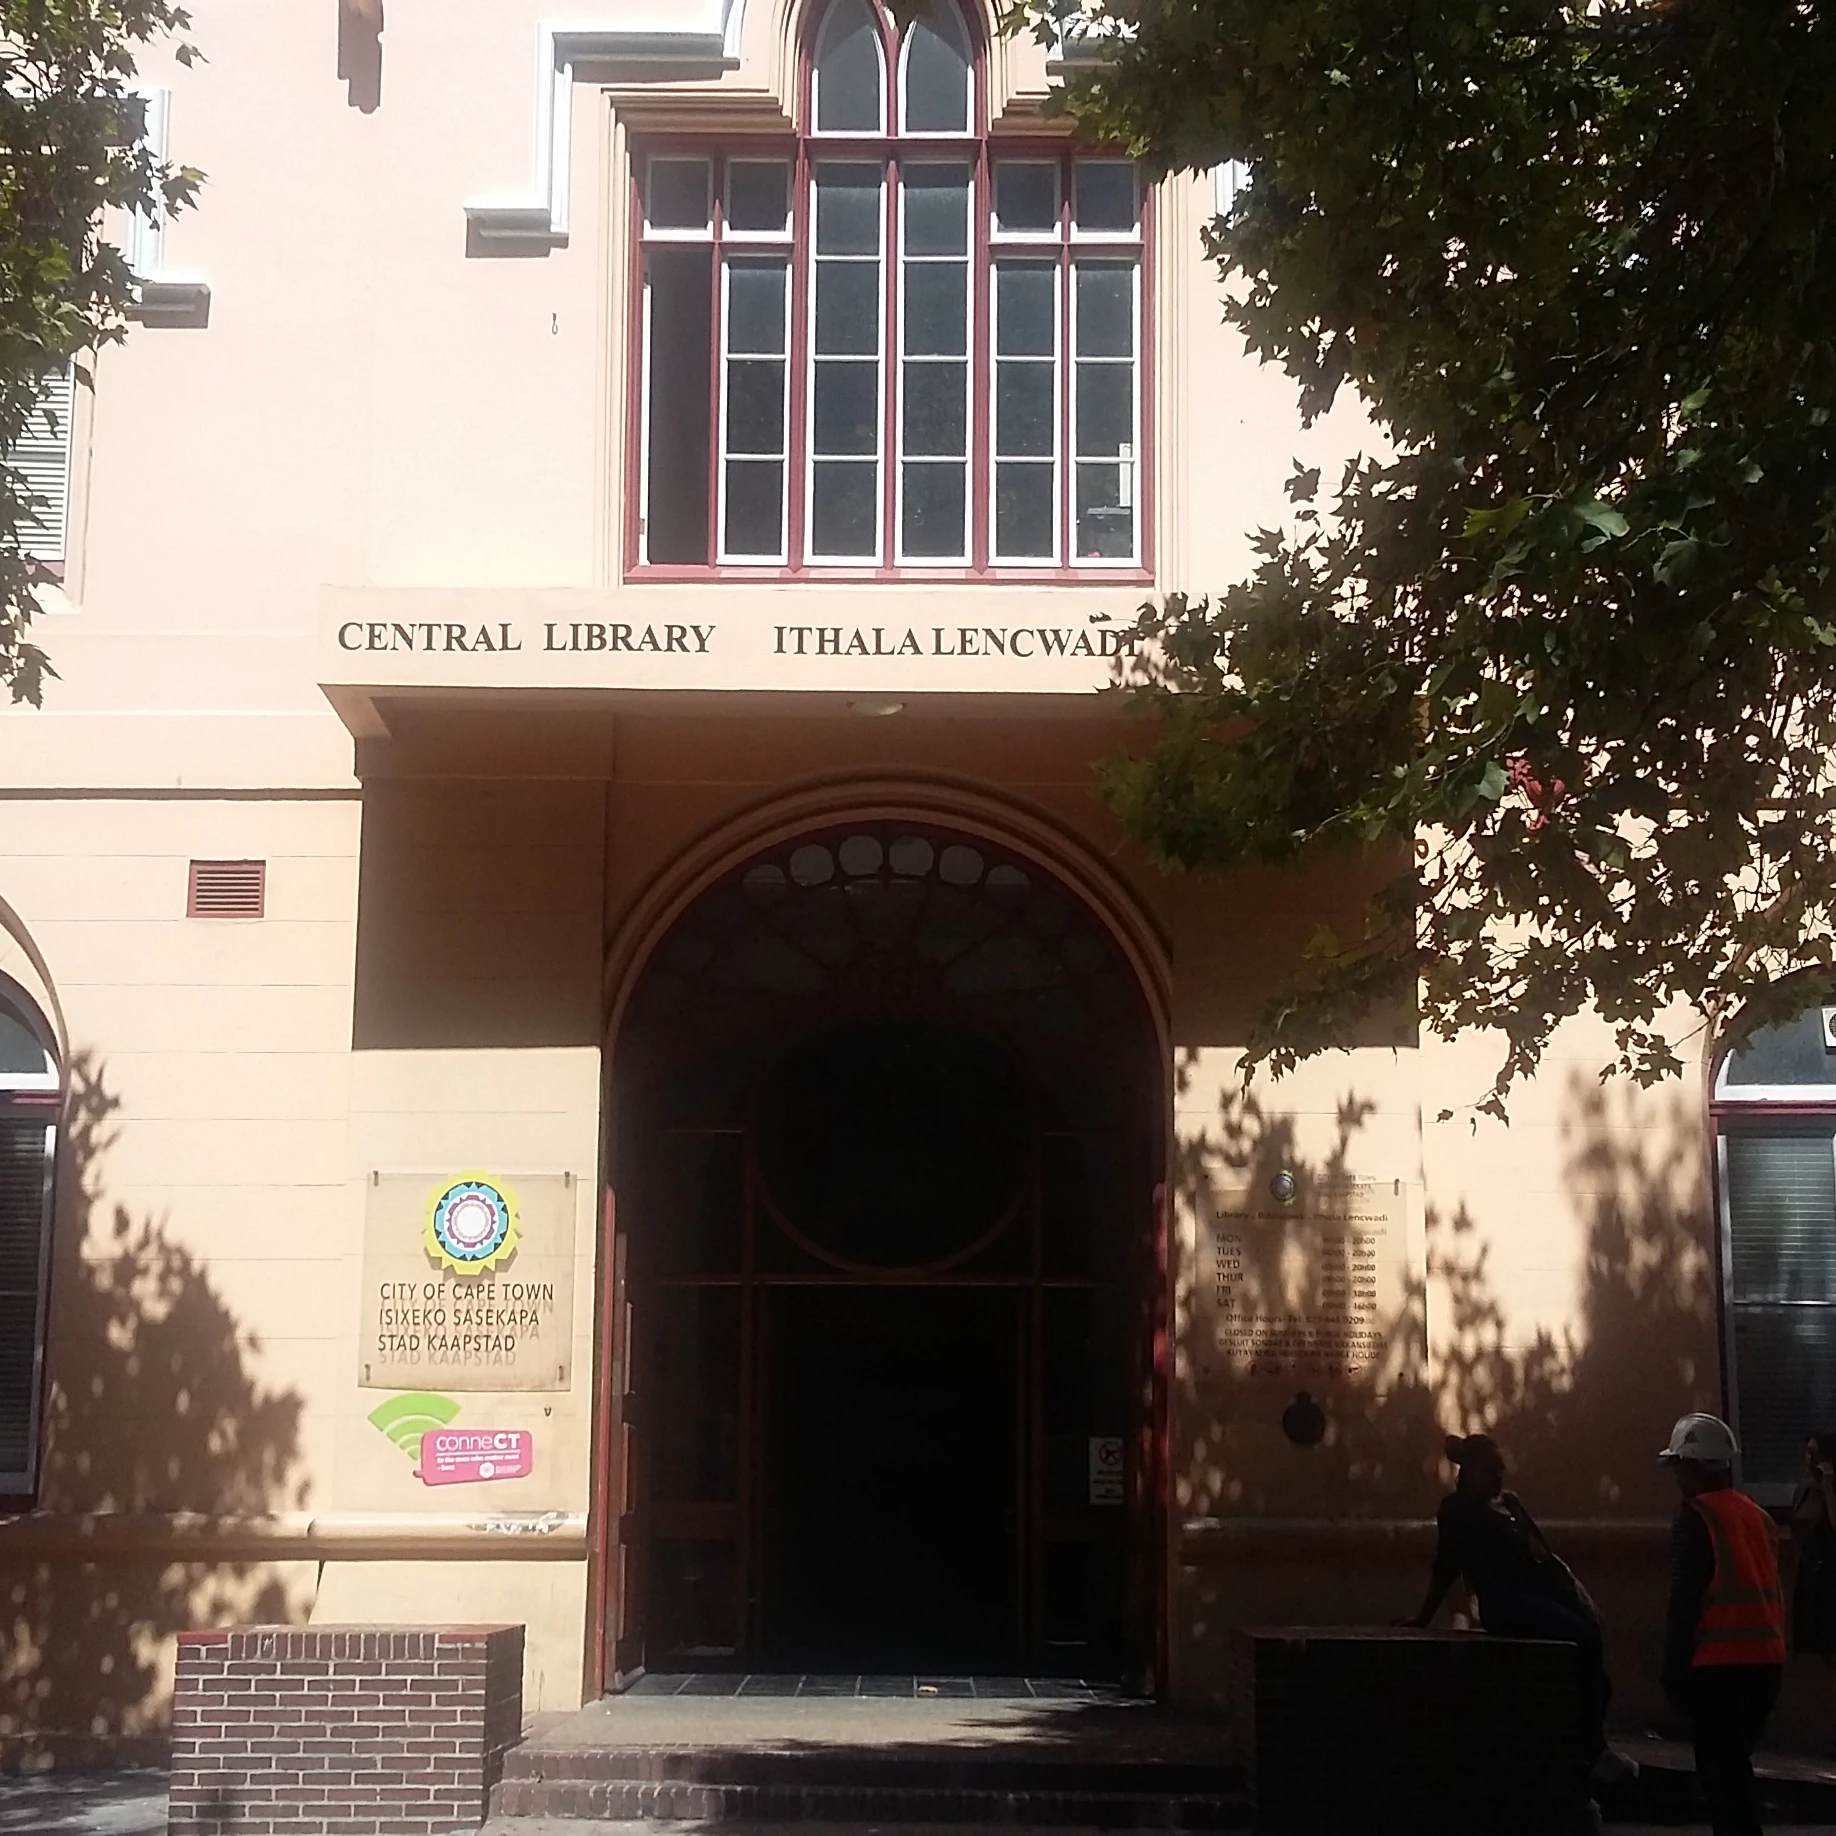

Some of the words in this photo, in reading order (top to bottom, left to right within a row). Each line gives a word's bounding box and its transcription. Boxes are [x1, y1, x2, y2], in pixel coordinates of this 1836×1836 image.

[338, 622, 522, 652] CENTRAL
[543, 623, 717, 653] LIBRARY
[773, 625, 922, 656] ITHALA
[1216, 1234, 1242, 1243] MON
[1217, 1247, 1242, 1257] TUES
[1216, 1260, 1240, 1269] WED
[1216, 1272, 1244, 1282] THUR
[380, 1283, 417, 1300] CITY
[423, 1283, 446, 1300] OF
[452, 1283, 496, 1301] CAPE
[502, 1283, 554, 1301] TOWN
[1216, 1286, 1232, 1295] FRI
[1216, 1299, 1236, 1309] SAT
[379, 1308, 447, 1326] ISIXEKO
[453, 1308, 540, 1326] SASEKAPA
[1224, 1328, 1254, 1337] CLOSED
[378, 1334, 421, 1351] STAD
[427, 1334, 516, 1352] KAAPSTAD
[436, 1433, 521, 1451] conneCT
